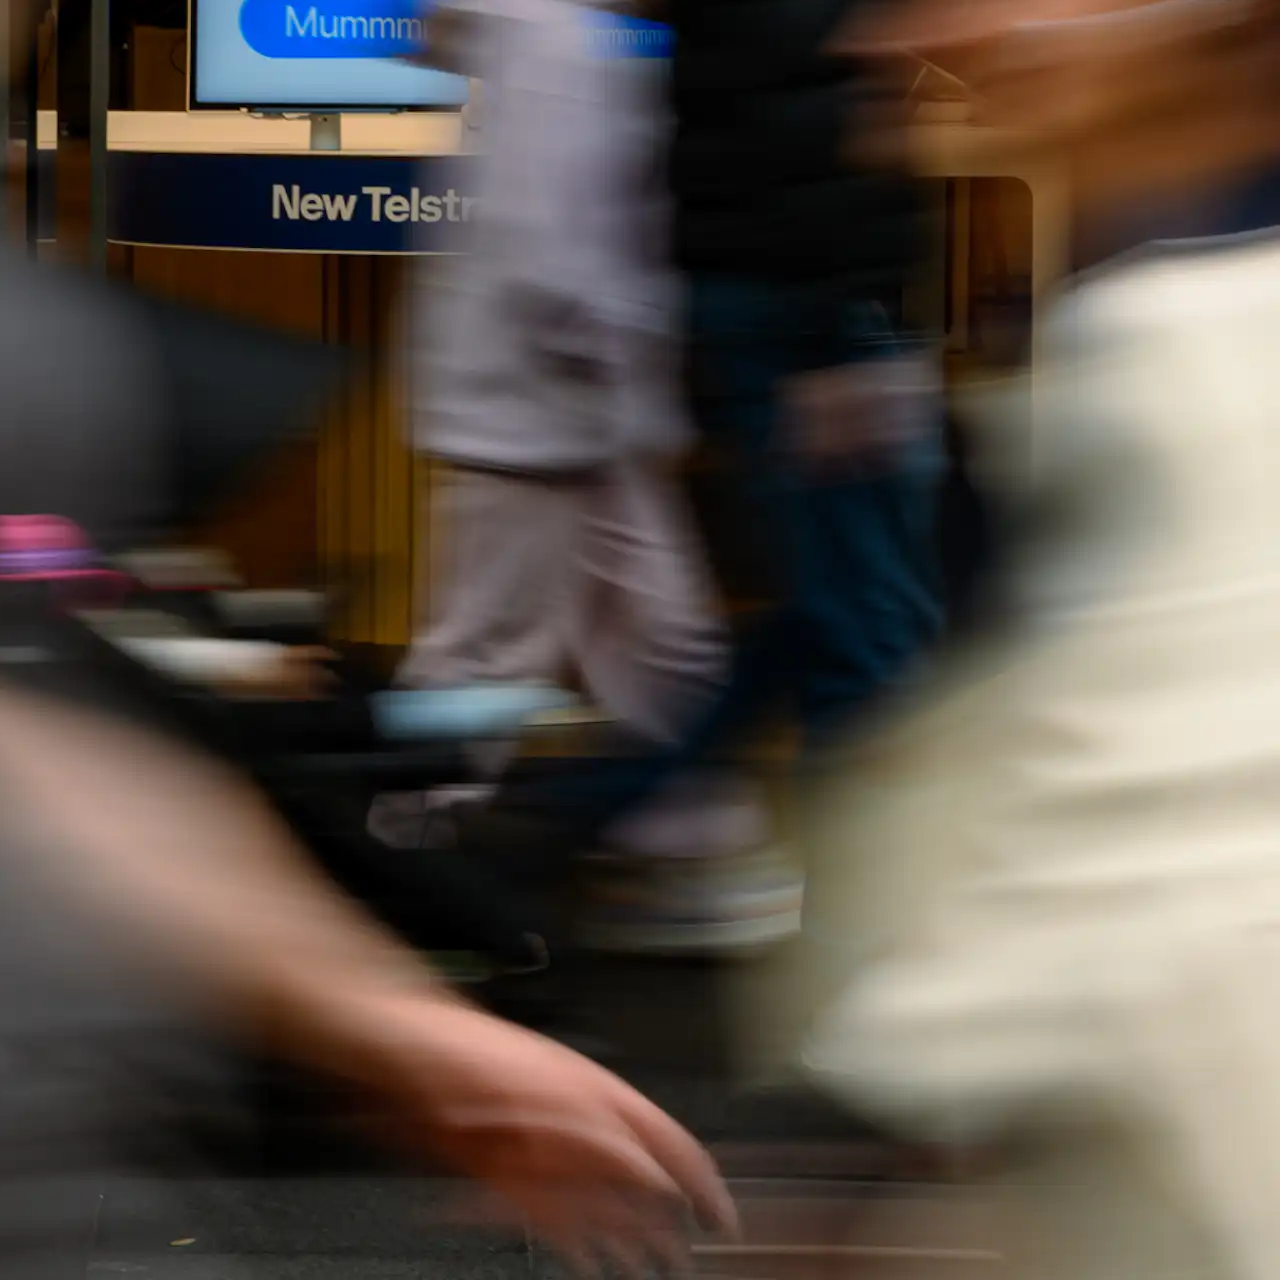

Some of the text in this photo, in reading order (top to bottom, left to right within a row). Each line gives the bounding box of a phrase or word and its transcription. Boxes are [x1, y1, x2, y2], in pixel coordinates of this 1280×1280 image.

[285, 5, 429, 40] Mummm
[272, 184, 484, 222] New Telstr
